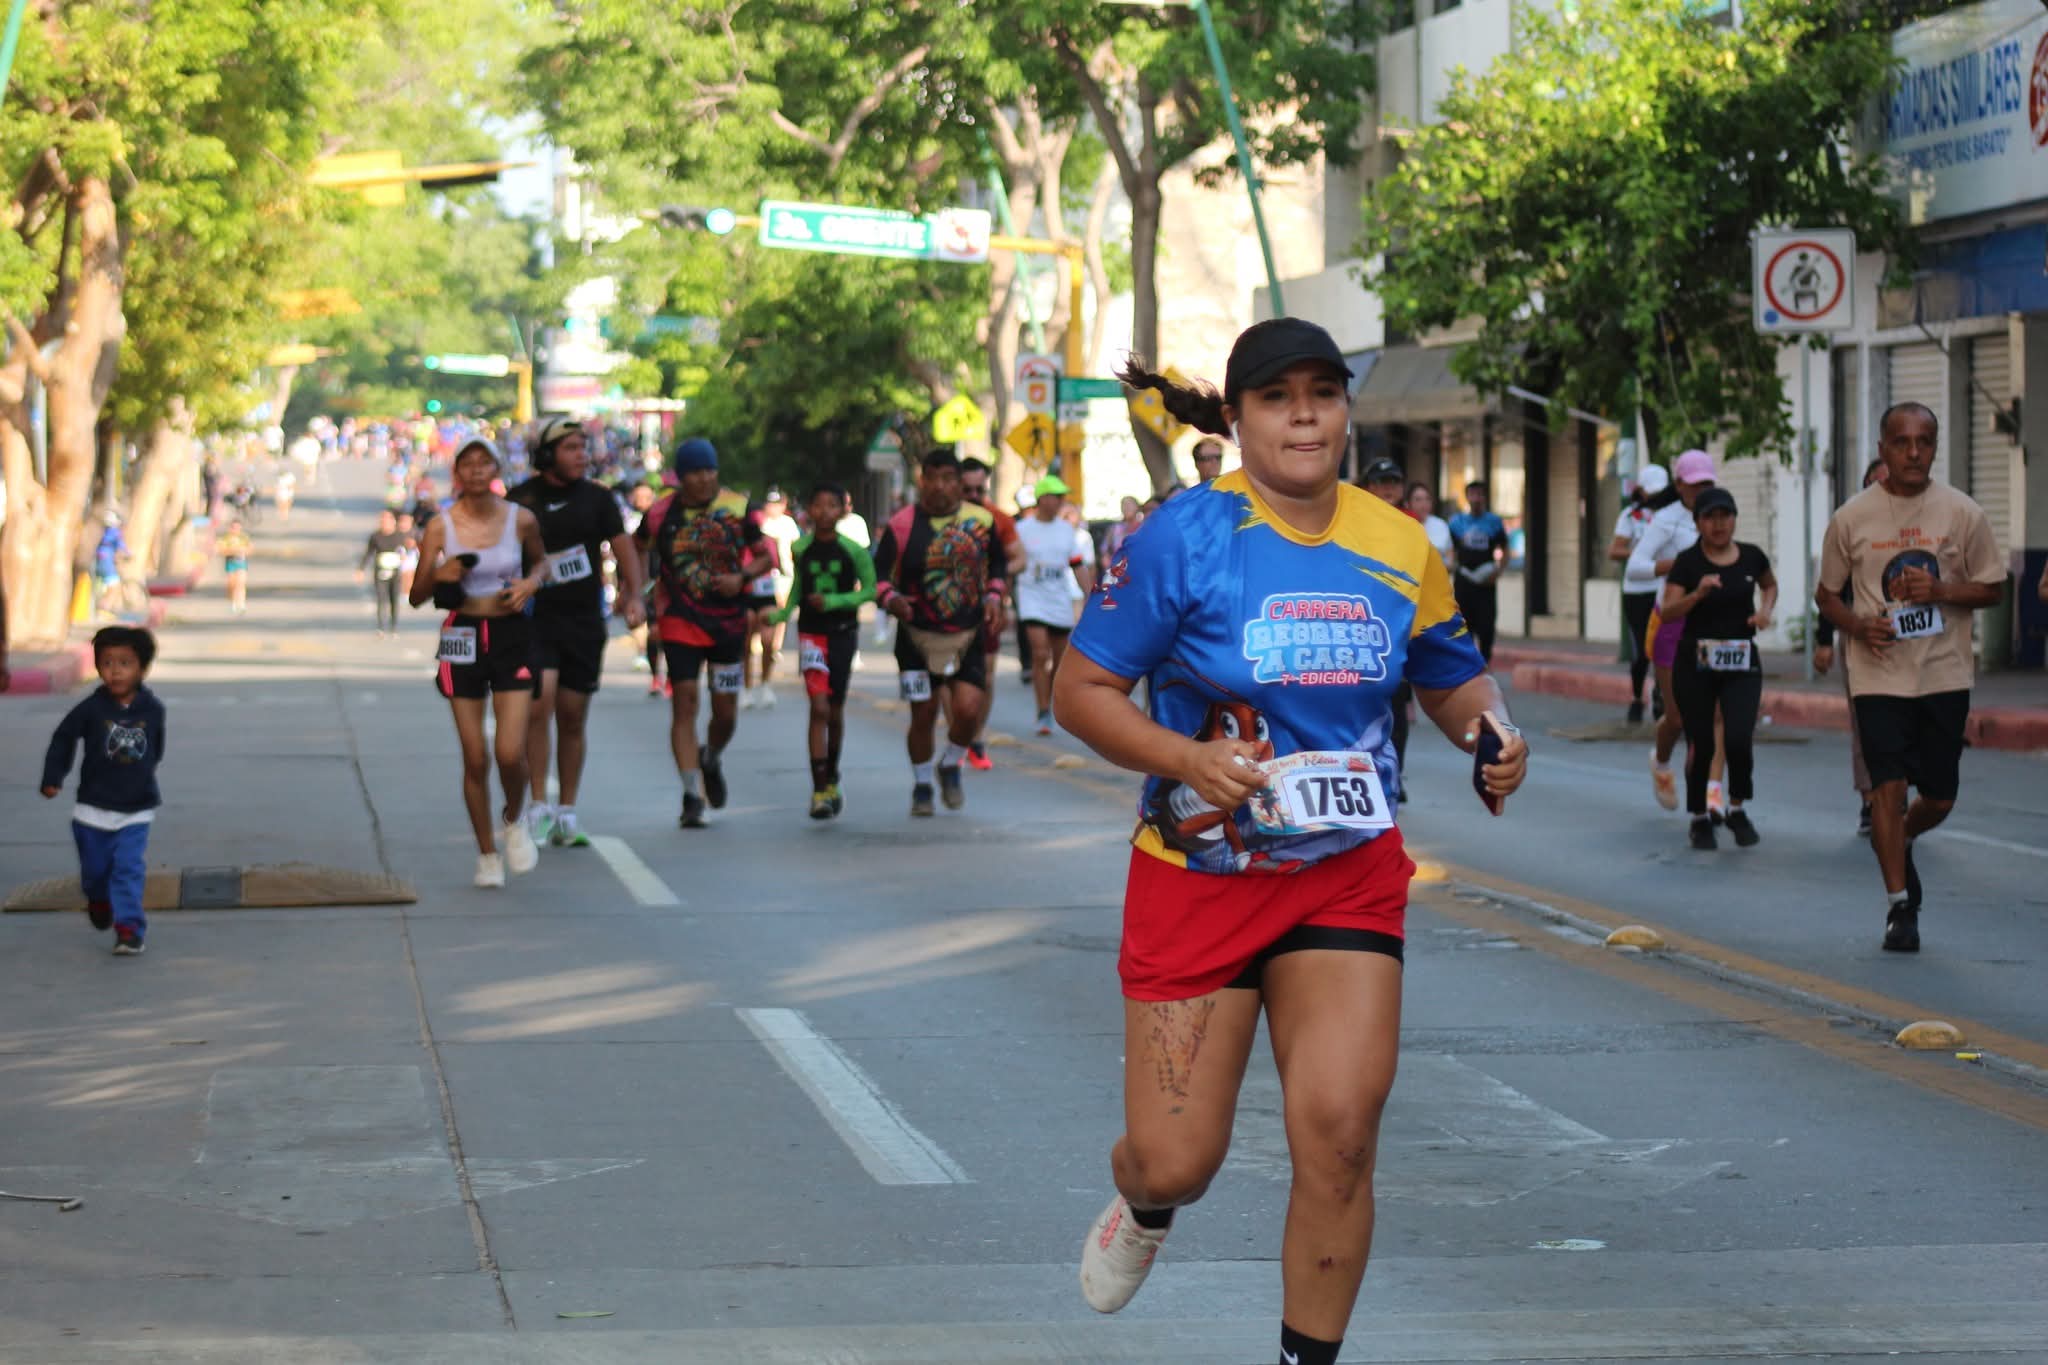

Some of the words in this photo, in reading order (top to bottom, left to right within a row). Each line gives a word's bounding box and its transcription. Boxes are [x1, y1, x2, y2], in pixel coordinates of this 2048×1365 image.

[1269, 600, 1367, 620] CARRERA
[1898, 607, 1934, 634] 1837
[1252, 622, 1384, 650] REGRESO
[1263, 649, 1286, 673] A
[1295, 647, 1378, 671] CASA
[1299, 669, 1360, 685] EDICIÓN
[1295, 776, 1375, 818] 1753
